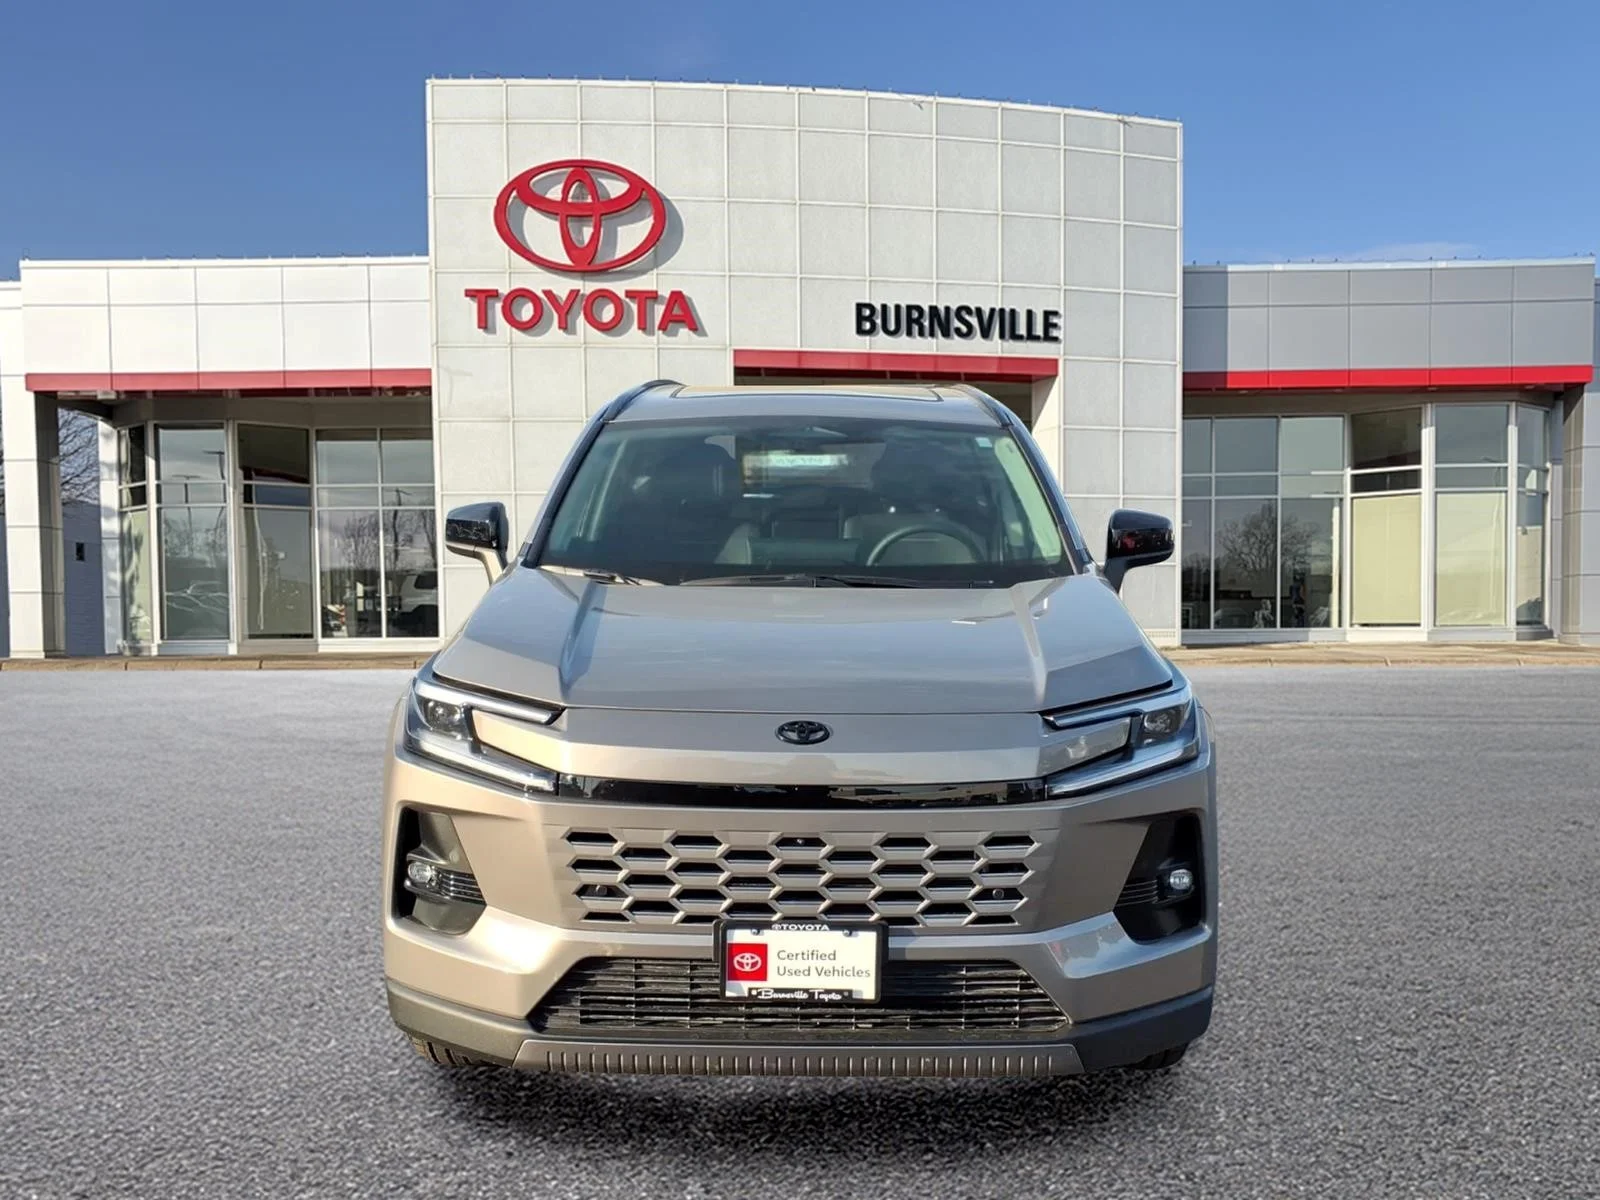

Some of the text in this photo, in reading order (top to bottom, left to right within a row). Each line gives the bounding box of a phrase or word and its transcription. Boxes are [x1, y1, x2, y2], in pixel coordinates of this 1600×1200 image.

[464, 287, 699, 332] TOYOTA
[855, 302, 1062, 343] BURNSVILLE
[777, 949, 837, 961] Certified
[777, 966, 871, 978] Used Vehicles
[809, 989, 842, 1002] Toyota
